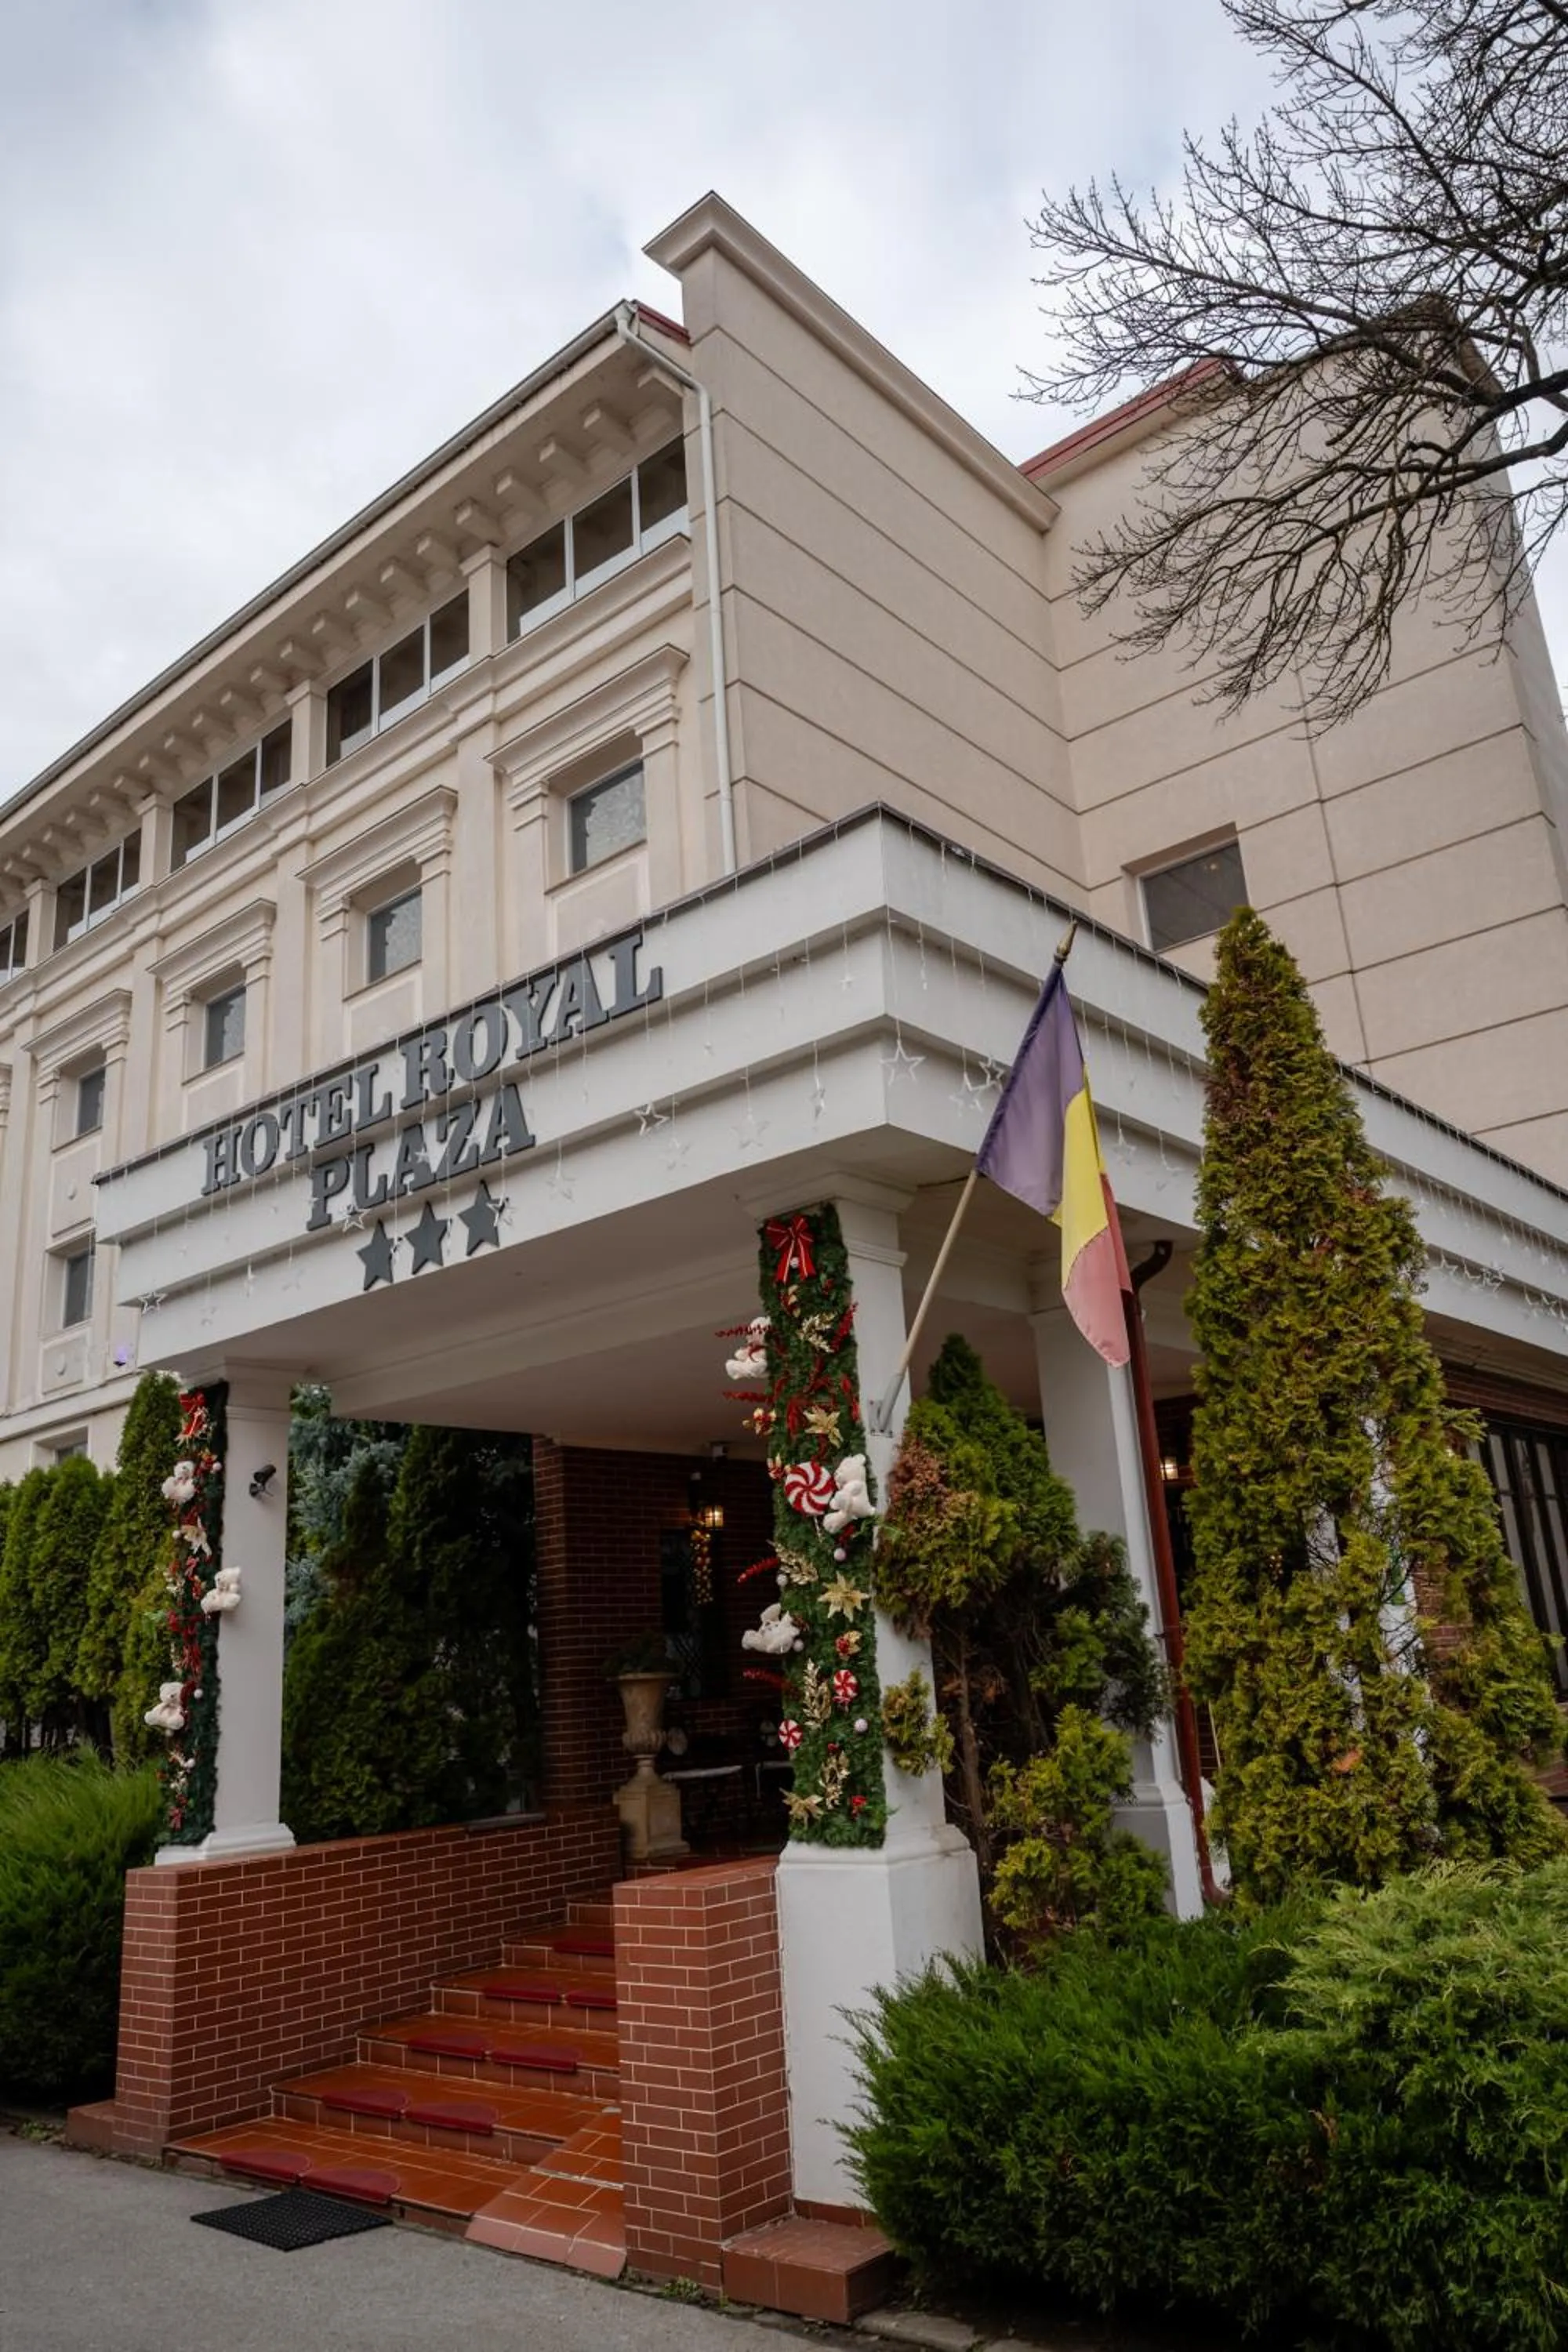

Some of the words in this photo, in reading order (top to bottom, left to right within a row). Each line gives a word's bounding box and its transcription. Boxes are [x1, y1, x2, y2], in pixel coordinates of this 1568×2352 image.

[201, 1063, 392, 1196] HOTEL
[400, 935, 663, 1110] ROYAL
[307, 1083, 535, 1231] PLAZA
